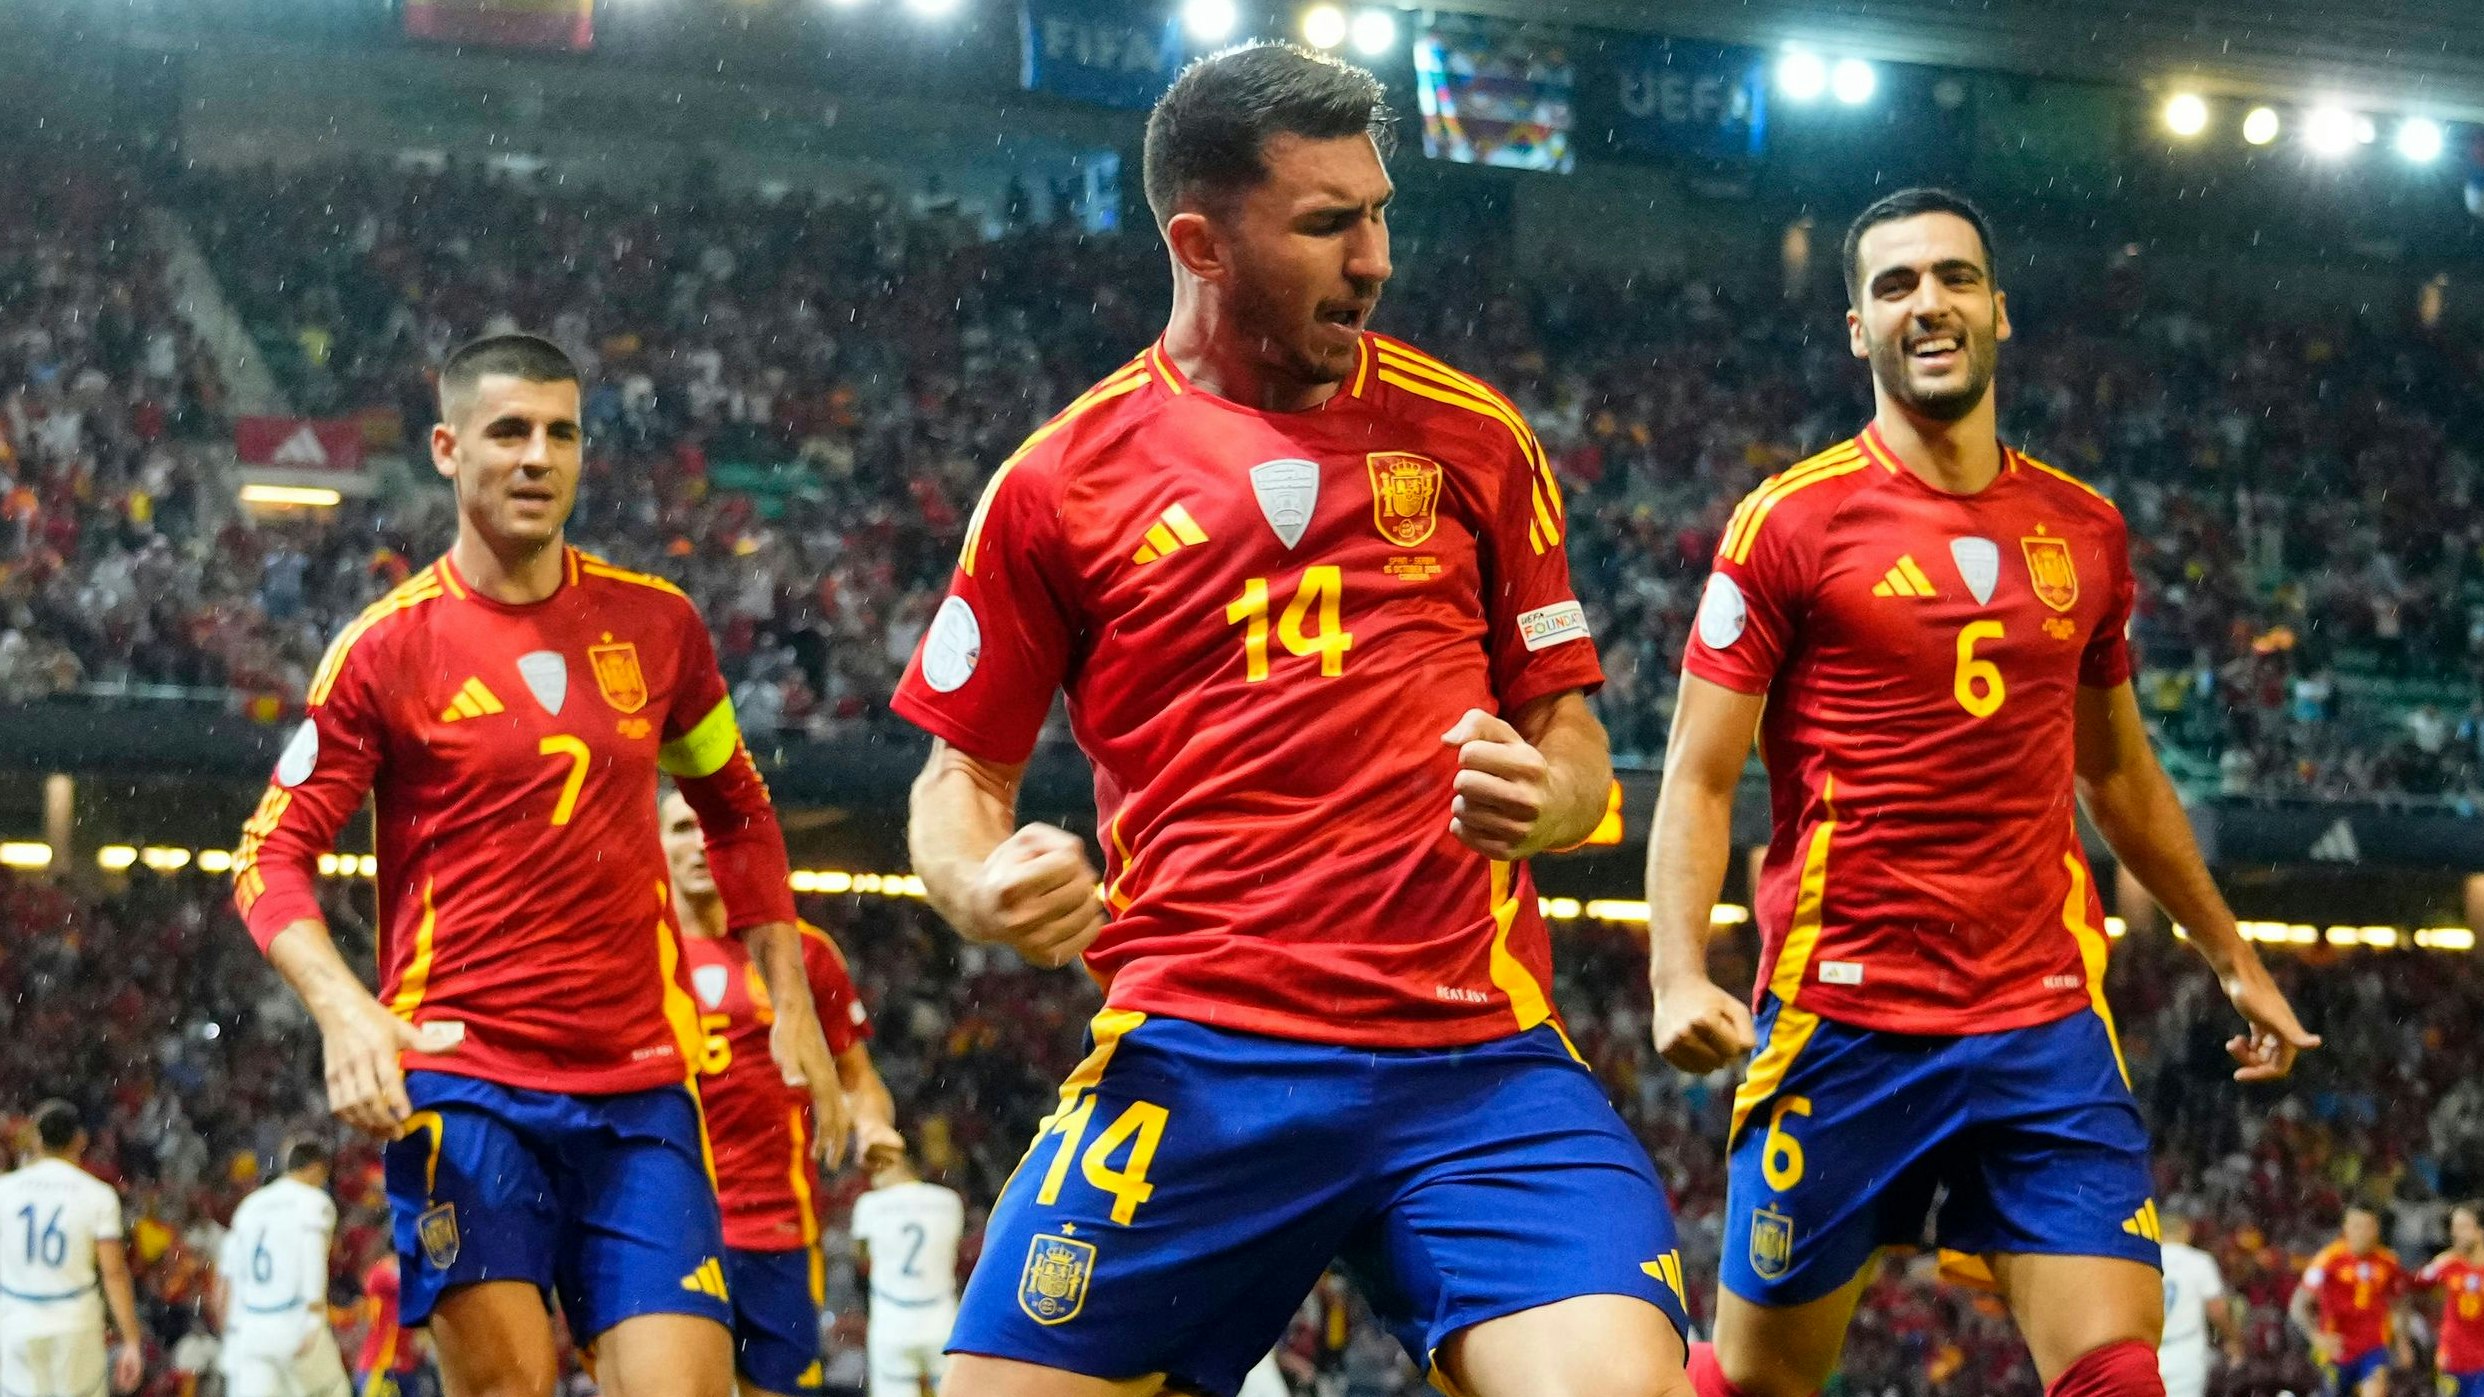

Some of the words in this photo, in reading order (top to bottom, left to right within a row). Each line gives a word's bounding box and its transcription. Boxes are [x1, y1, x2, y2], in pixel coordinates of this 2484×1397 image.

[1044, 18, 1162, 73] FIFA
[1226, 565, 1353, 682] 14
[1521, 612, 1544, 626] UEFA
[1954, 620, 2005, 718] 6
[539, 734, 590, 826] 7
[700, 1013, 733, 1075] 5
[1036, 1093, 1169, 1227] 14
[1762, 1095, 1812, 1191] 6
[17, 1202, 67, 1268] 16
[253, 1224, 273, 1283] 6
[902, 1223, 925, 1276] 2
